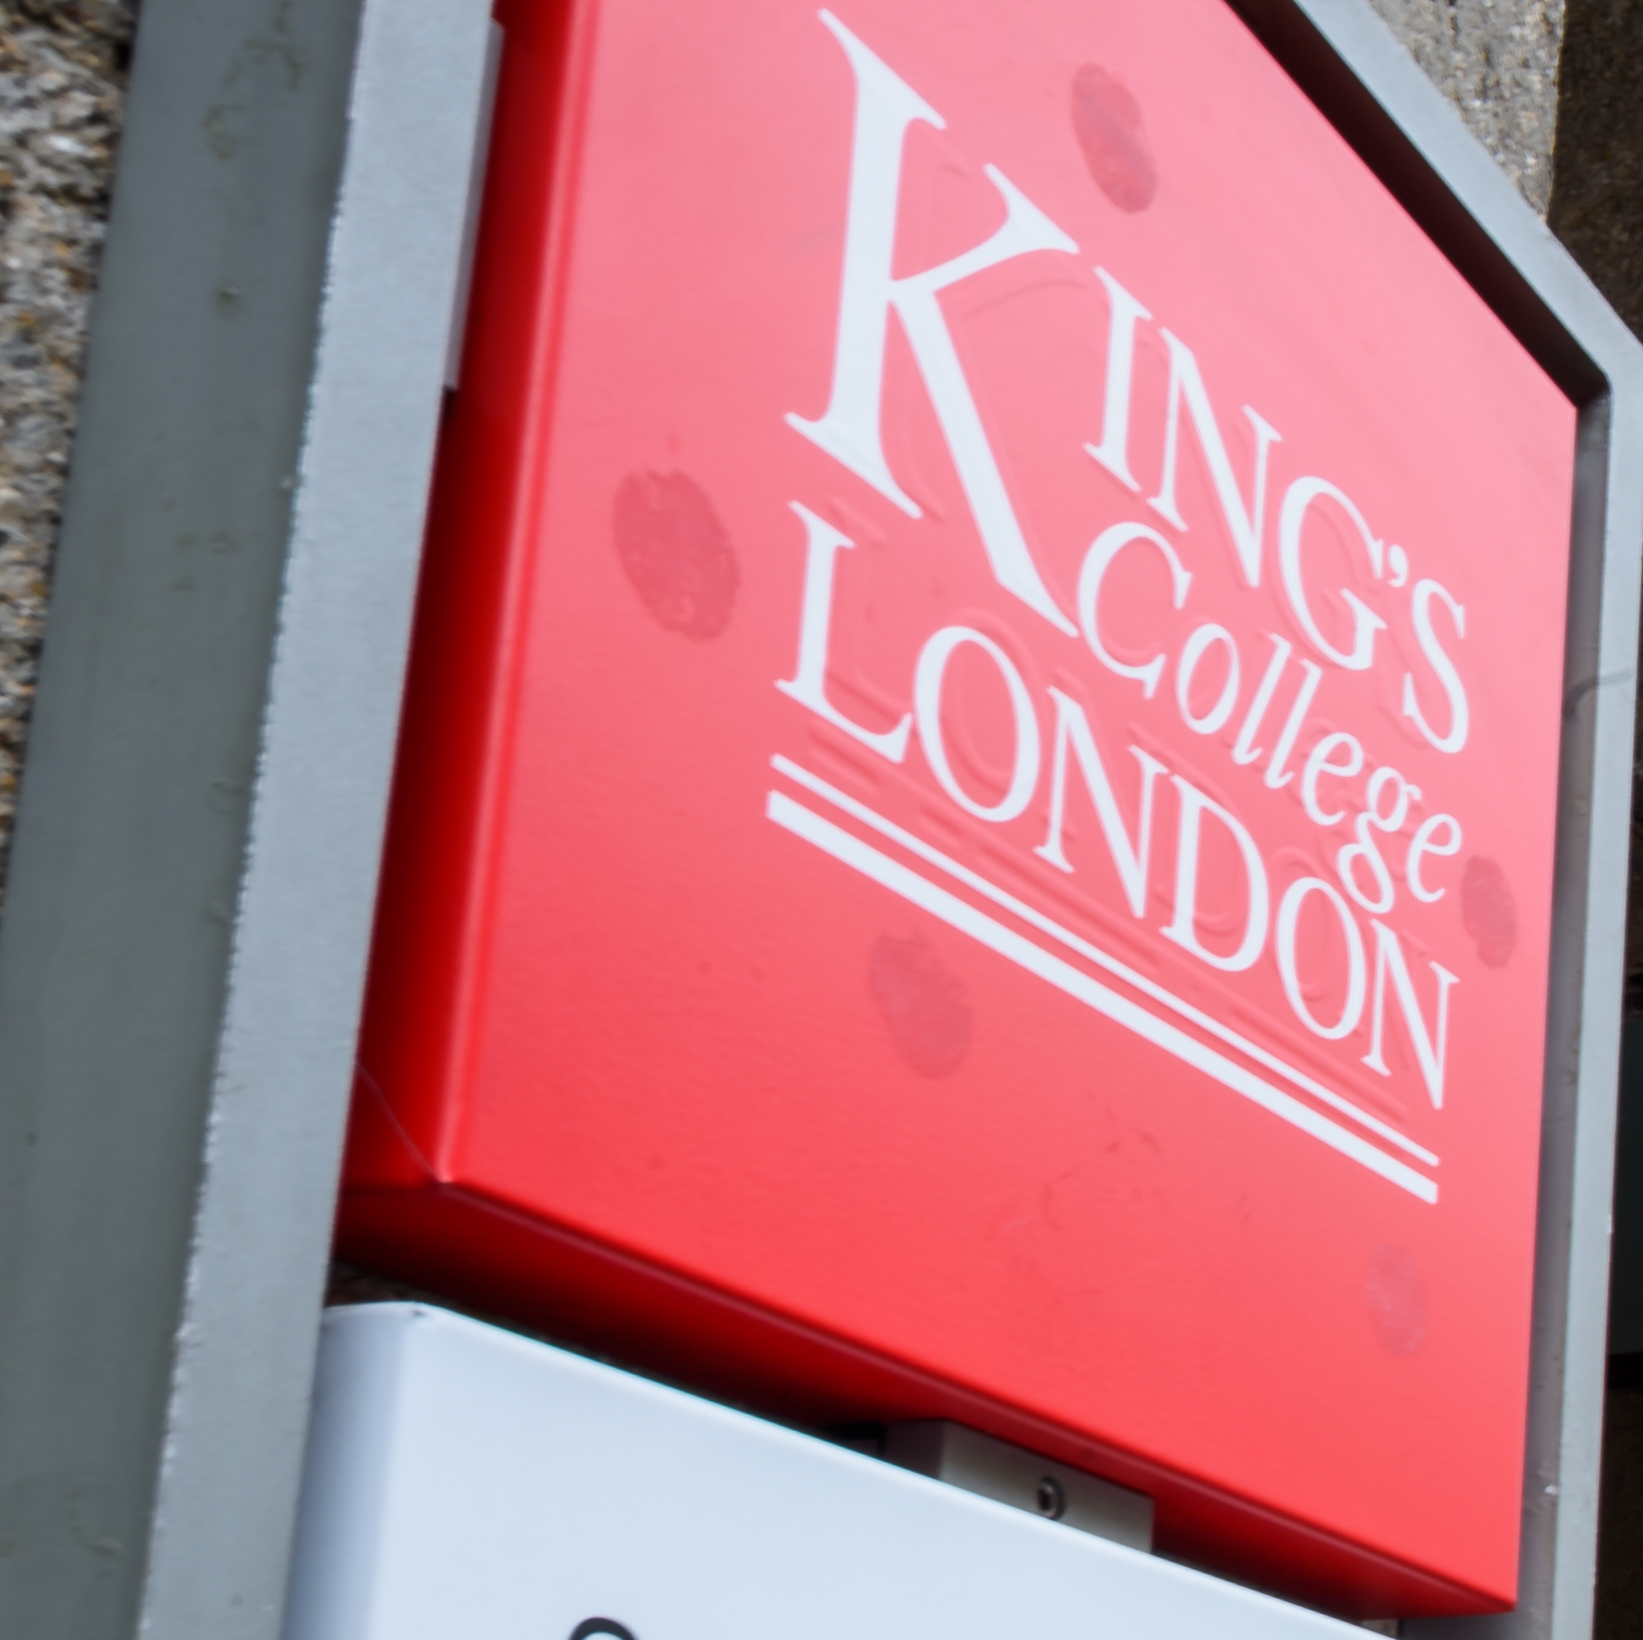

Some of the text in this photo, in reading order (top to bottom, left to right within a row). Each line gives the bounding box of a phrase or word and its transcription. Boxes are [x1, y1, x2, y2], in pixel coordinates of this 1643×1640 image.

[784, 8, 1469, 756] KING'S
[773, 500, 1459, 1110] LONDON
[1076, 520, 1463, 915] College
